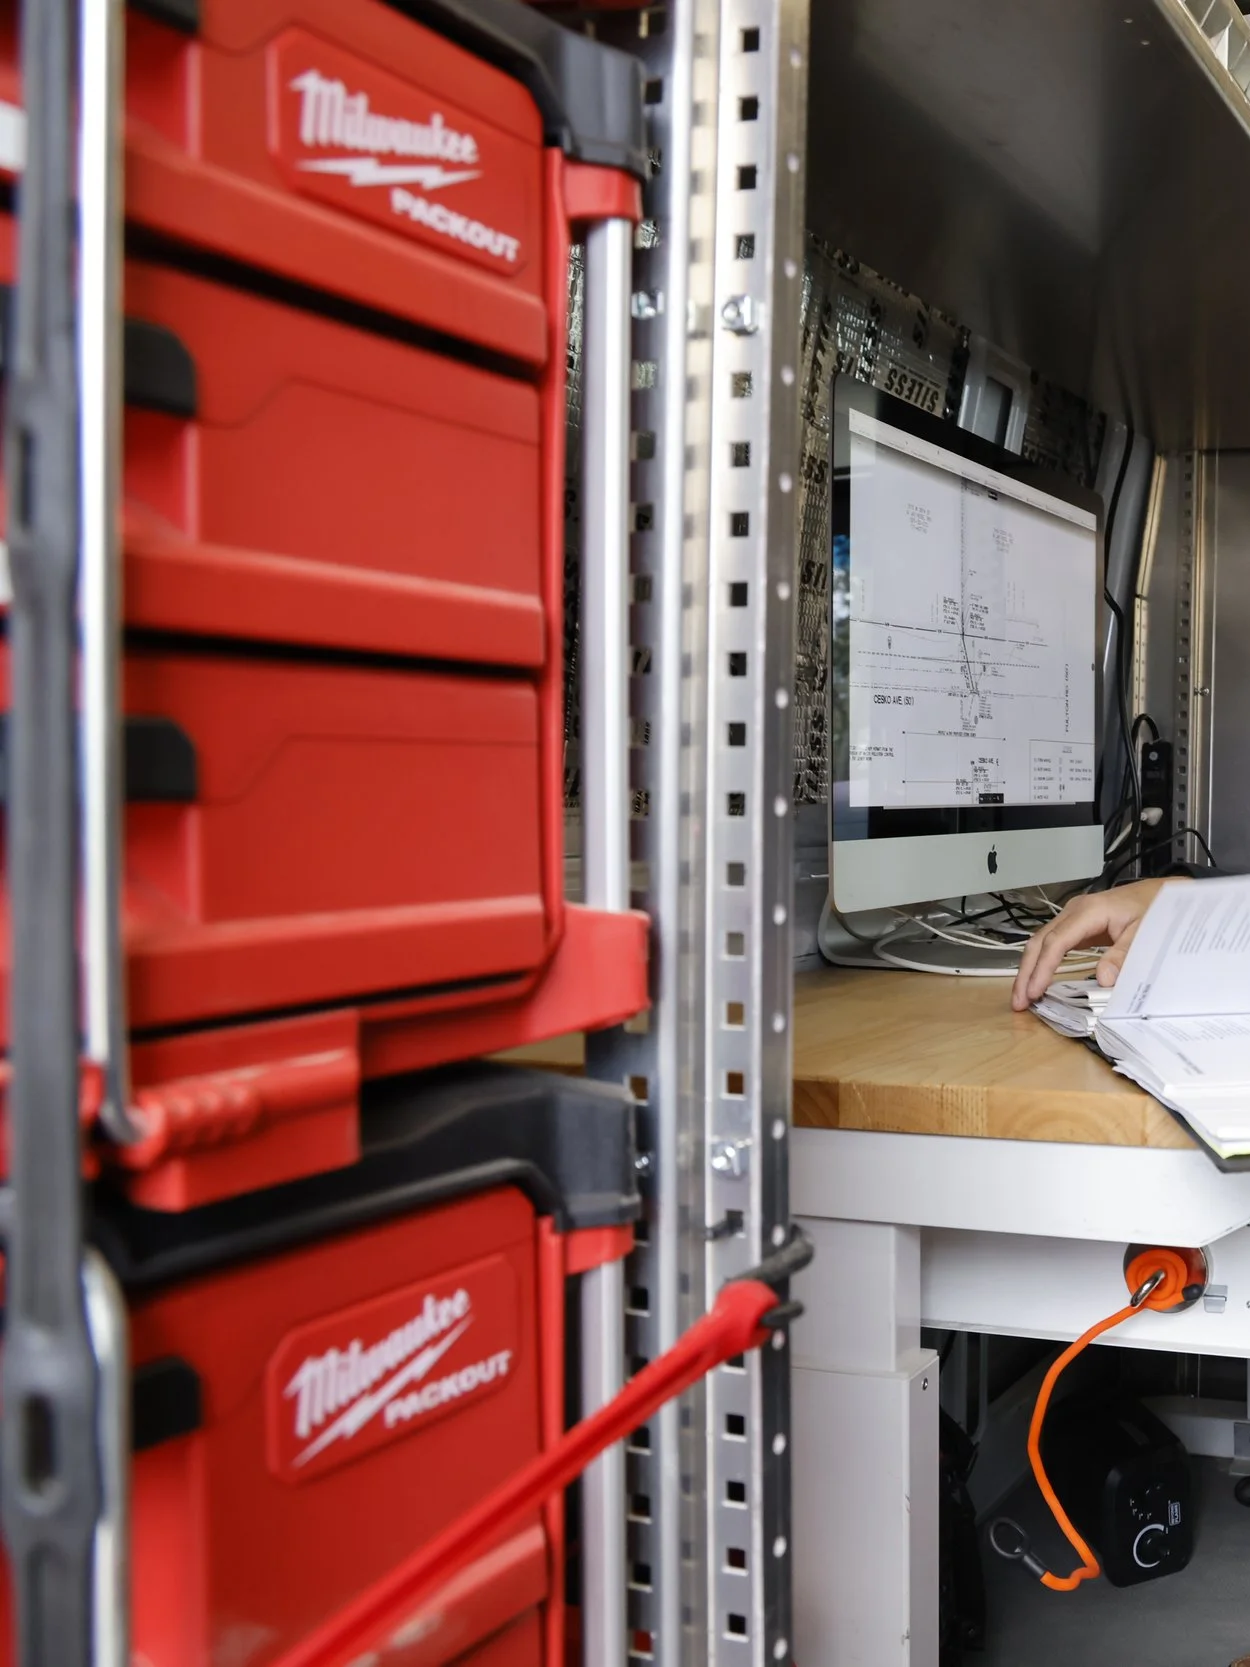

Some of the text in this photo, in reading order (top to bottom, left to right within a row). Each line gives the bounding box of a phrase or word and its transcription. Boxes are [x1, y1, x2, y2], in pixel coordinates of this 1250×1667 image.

[290, 68, 478, 164] Milwaukee
[390, 187, 520, 262] PACKOUT
[284, 1288, 471, 1438] Milwaukee
[384, 1348, 513, 1429] PACKOUT
